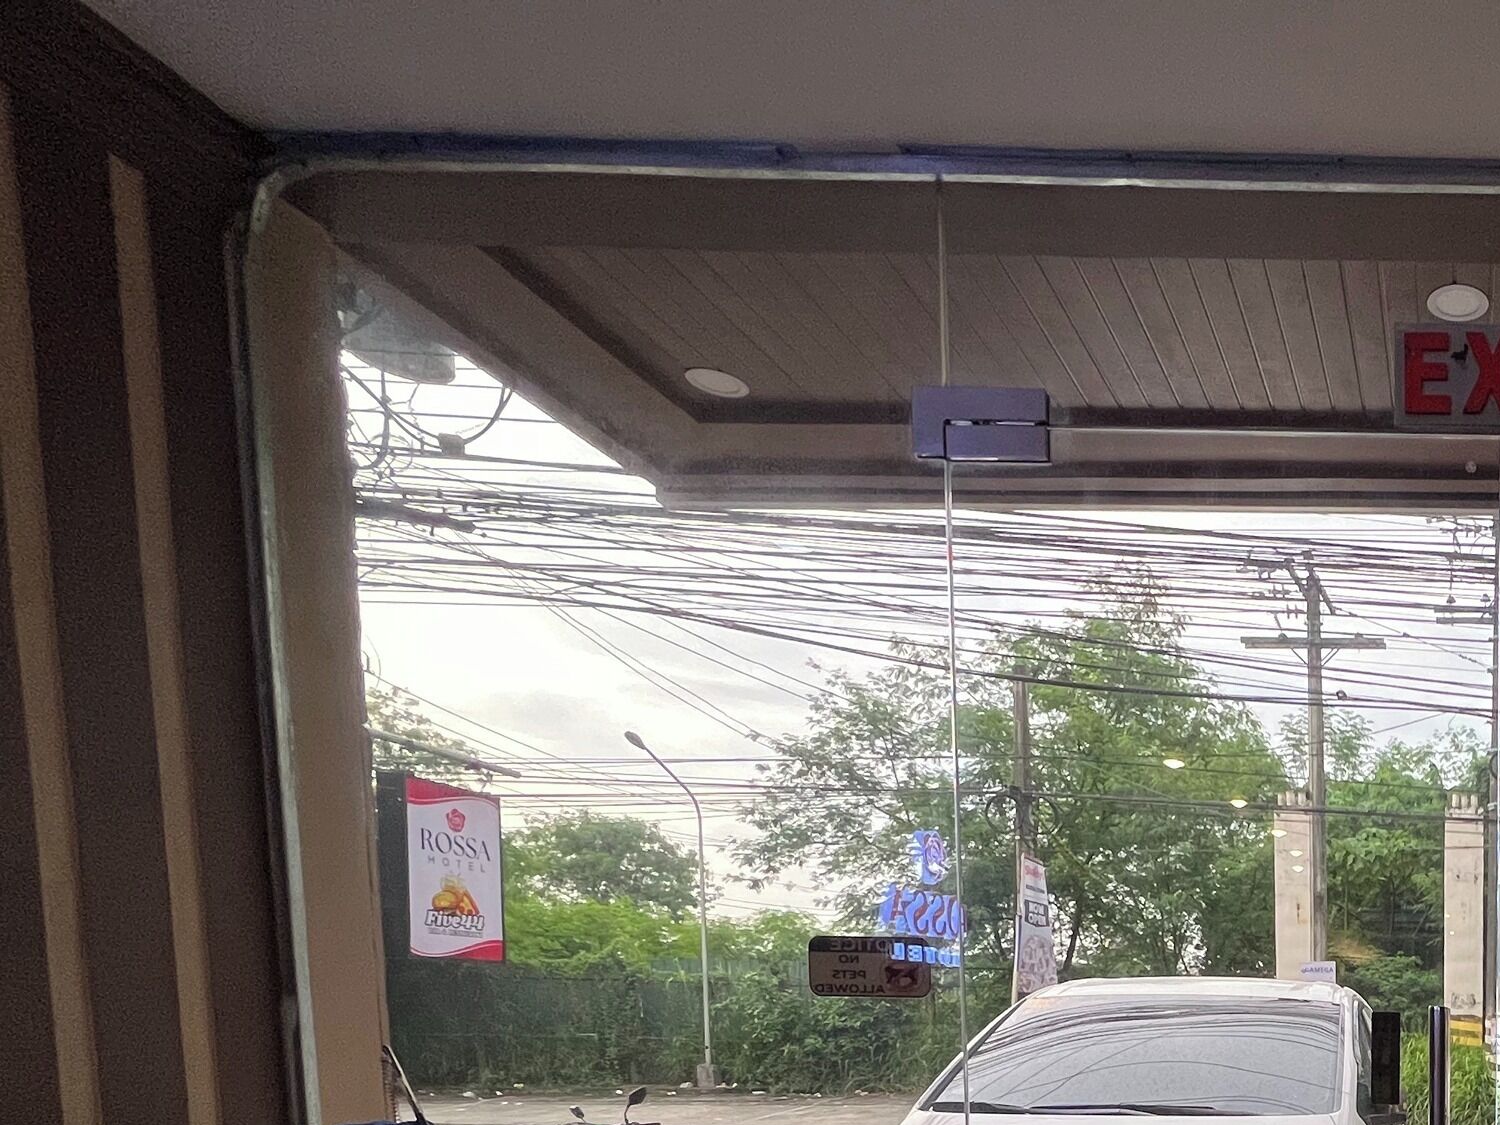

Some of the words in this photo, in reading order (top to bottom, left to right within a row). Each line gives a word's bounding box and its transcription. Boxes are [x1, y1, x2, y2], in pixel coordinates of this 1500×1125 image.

[421, 828, 490, 862] ROSSA
[428, 855, 486, 873] HOTEL
[424, 909, 485, 931] Five44
